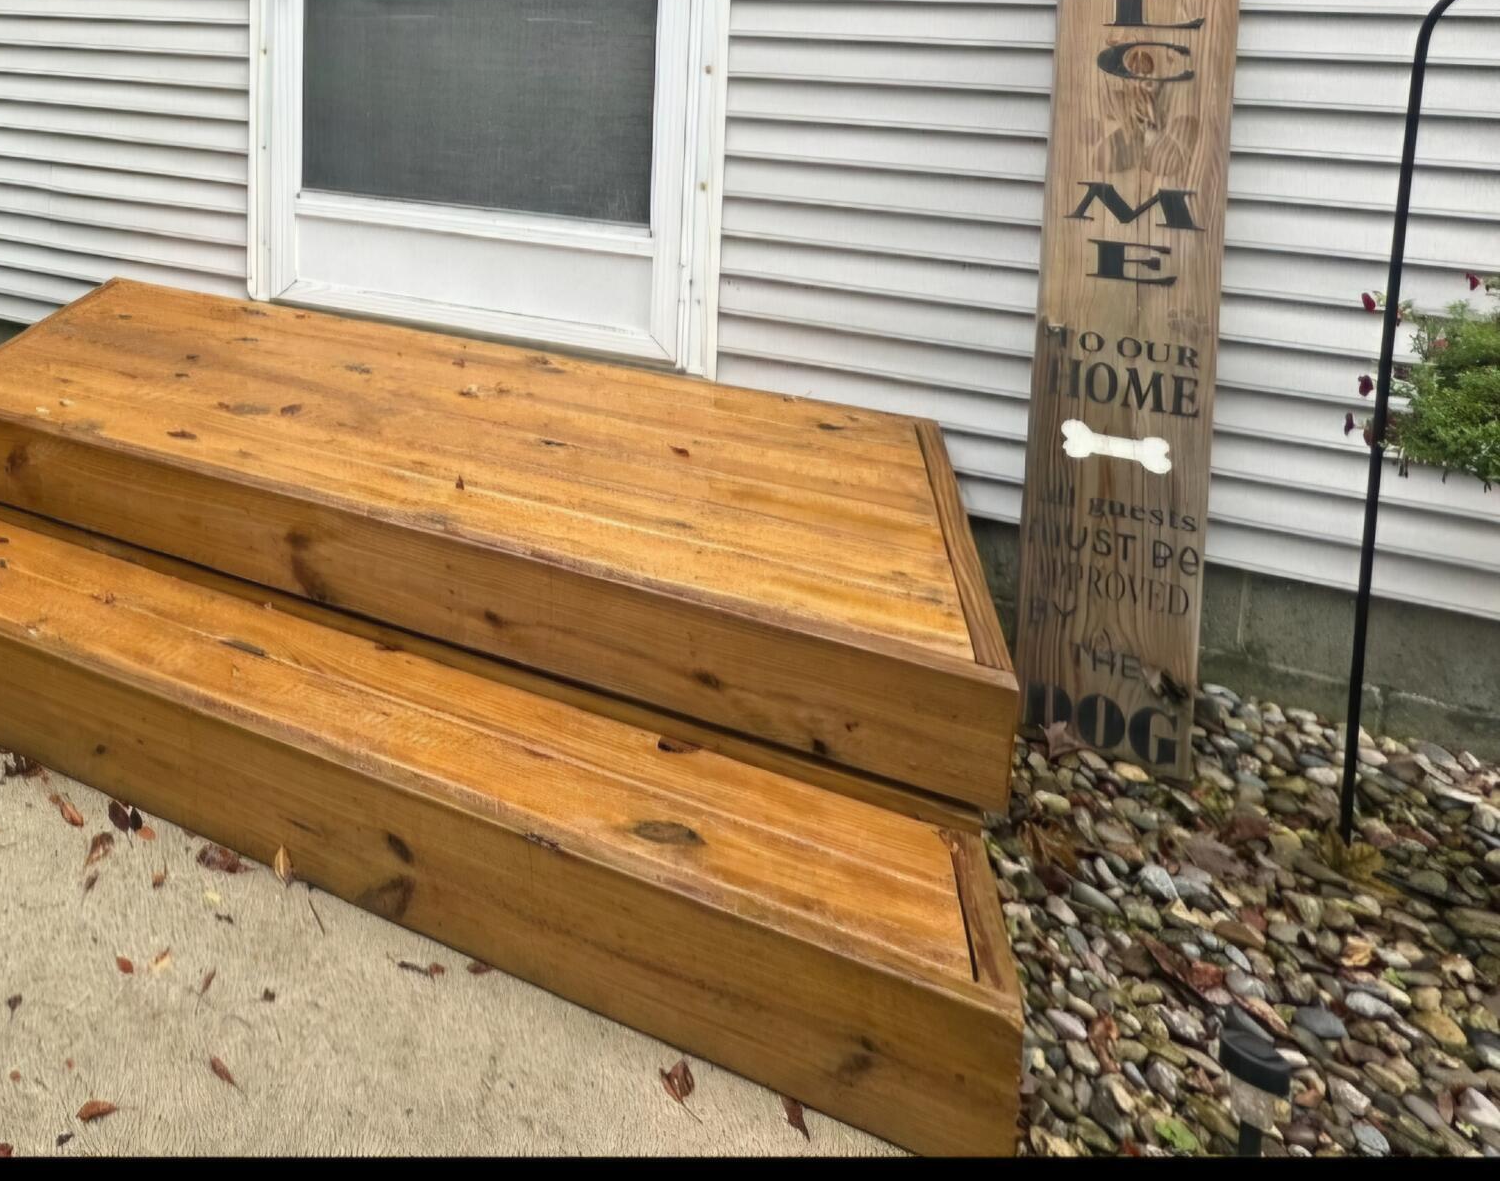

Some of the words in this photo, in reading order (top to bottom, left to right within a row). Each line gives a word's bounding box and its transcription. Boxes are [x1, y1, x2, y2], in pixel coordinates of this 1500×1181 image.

[1046, 324, 1105, 354] TO
[1117, 336, 1199, 369] OUR
[1048, 356, 1199, 418] HOME
[1088, 497, 1197, 532] guests
[1070, 641, 1141, 681] THE
[1026, 680, 1178, 766] DOG
